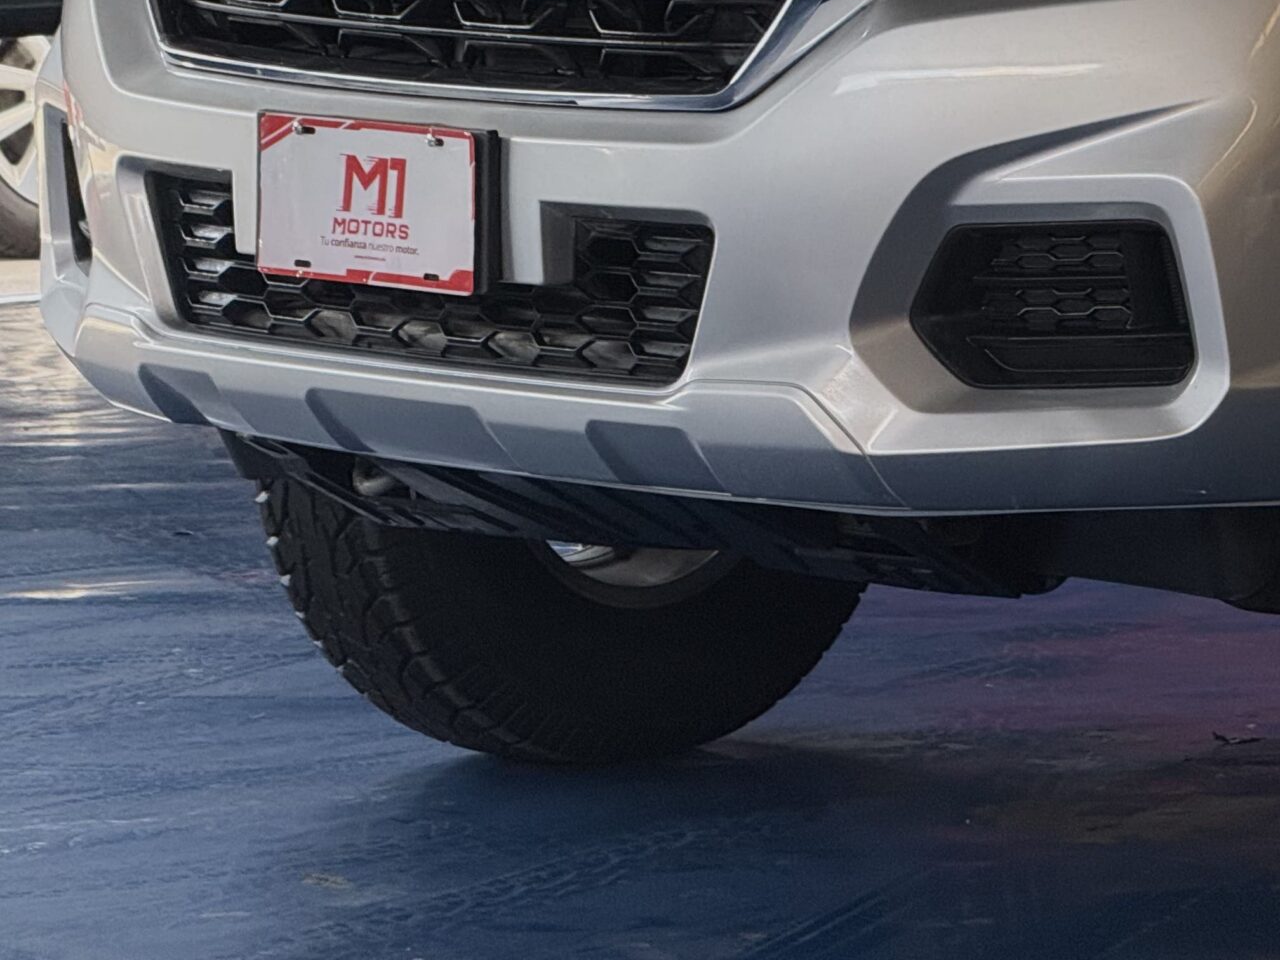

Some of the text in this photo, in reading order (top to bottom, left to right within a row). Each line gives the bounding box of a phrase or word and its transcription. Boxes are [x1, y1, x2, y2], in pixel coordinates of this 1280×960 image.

[335, 153, 407, 219] M1
[331, 217, 410, 240] MOTORS
[320, 235, 330, 246] Tu
[368, 241, 394, 253] nuestro
